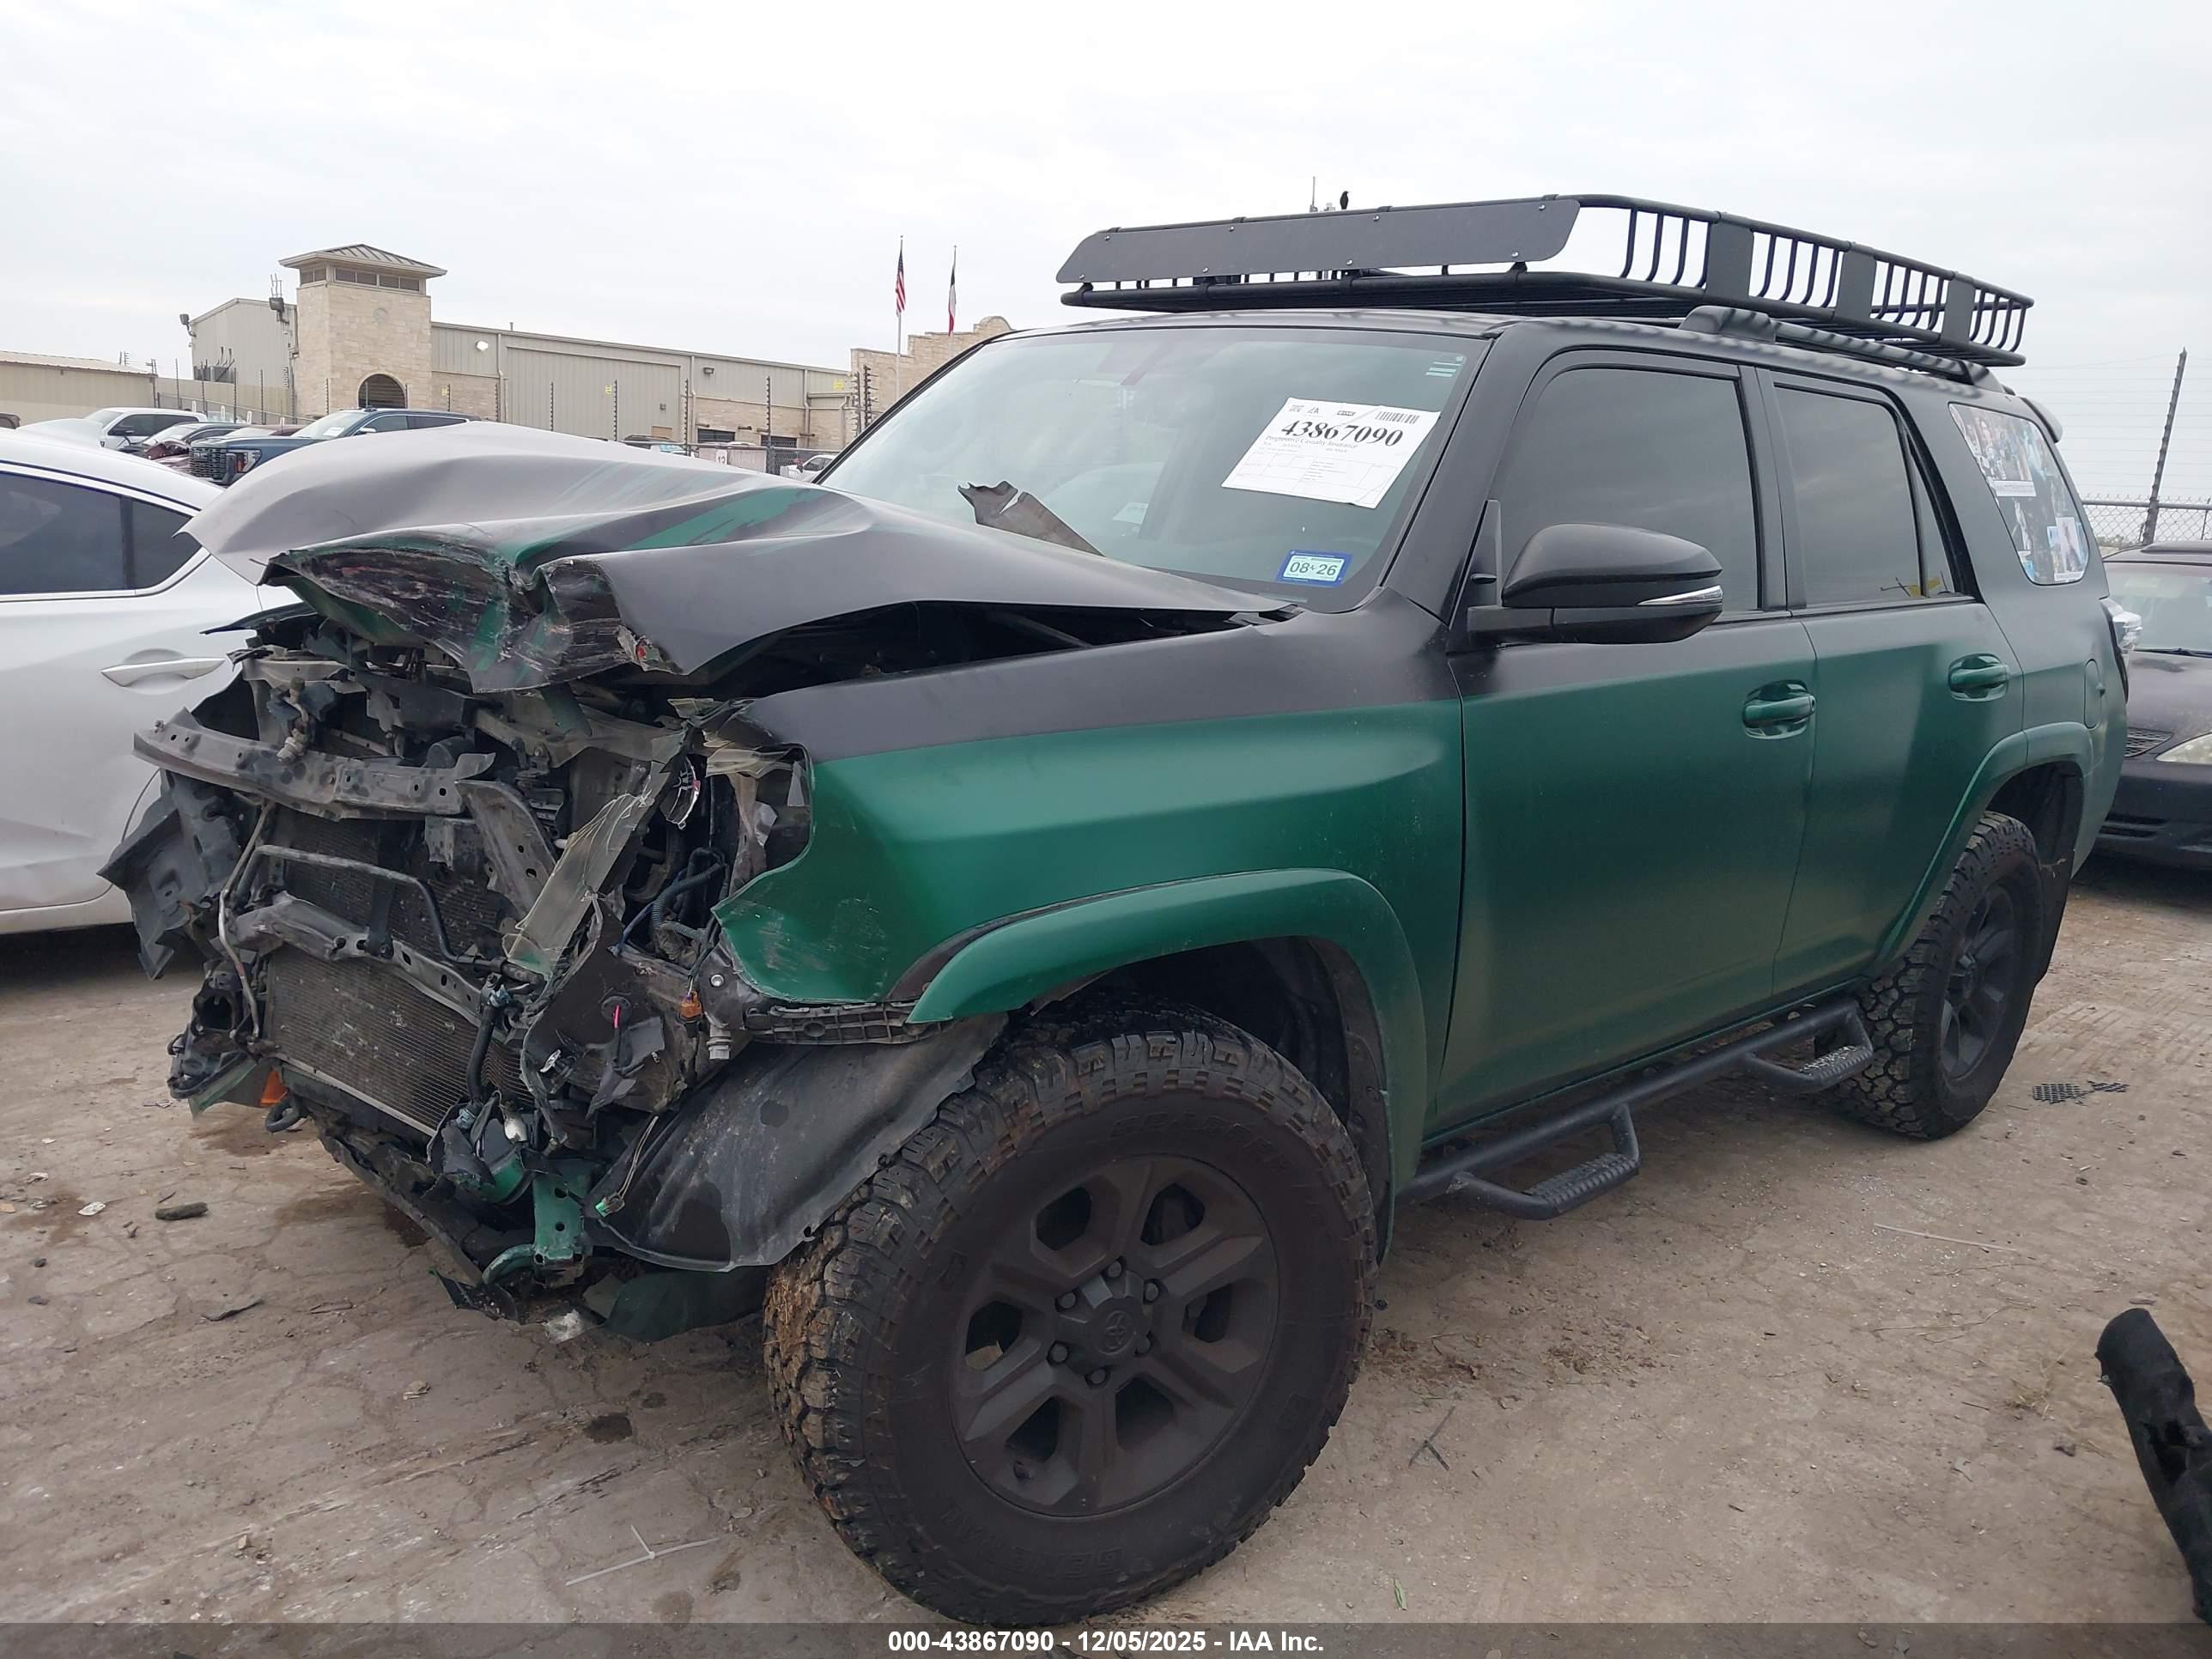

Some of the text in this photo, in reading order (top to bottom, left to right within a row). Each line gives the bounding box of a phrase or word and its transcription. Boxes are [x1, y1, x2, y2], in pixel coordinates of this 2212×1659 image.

[1282, 421, 1404, 447] 43867090
[1290, 562, 1338, 576] 08 26
